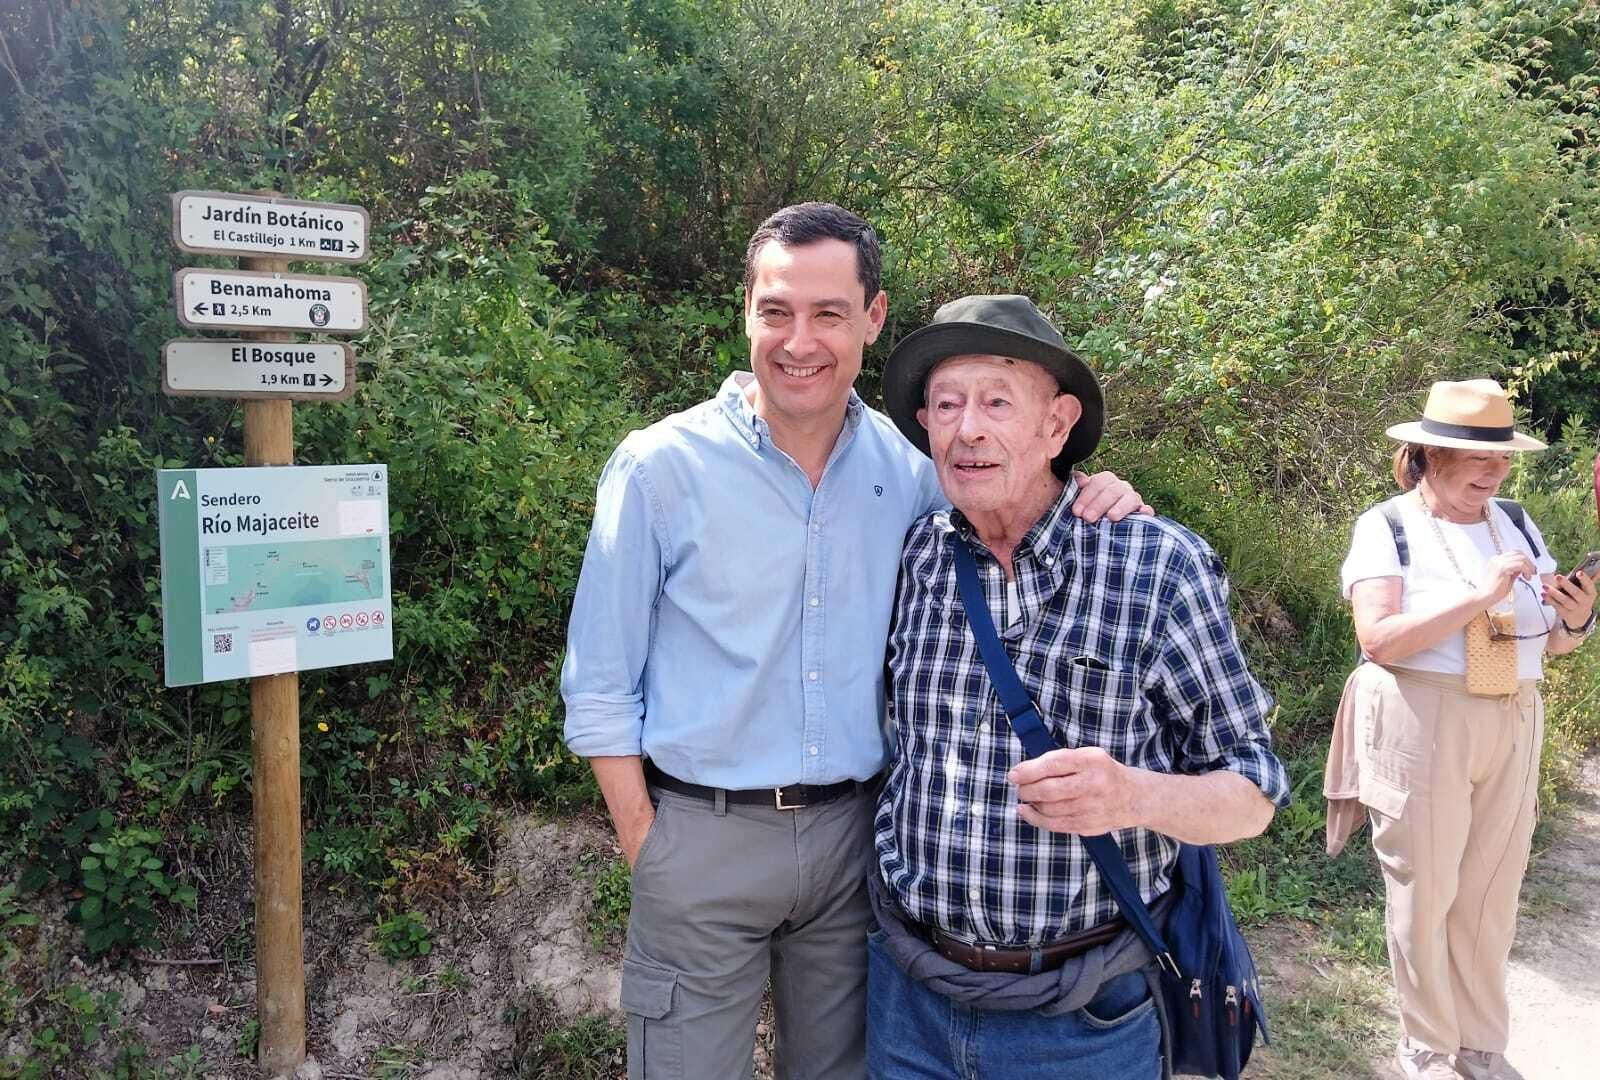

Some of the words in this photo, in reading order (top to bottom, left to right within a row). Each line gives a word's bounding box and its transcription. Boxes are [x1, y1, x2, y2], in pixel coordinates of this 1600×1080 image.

[202, 205, 262, 225] Jardín
[267, 210, 344, 232] Botánico
[213, 230, 225, 241] El
[228, 231, 285, 247] Castillejo
[290, 237, 296, 247] 1
[299, 237, 316, 249] Km
[210, 279, 332, 301] Benamahoma
[231, 305, 249, 317] 2,5
[252, 305, 272, 317] Km
[231, 347, 247, 362] El
[252, 348, 316, 367] Bosque
[261, 374, 278, 386] 1,9
[280, 374, 299, 385] Km
[200, 493, 261, 507] Sendero
[202, 513, 232, 535] Río
[236, 511, 320, 536] Majaceite
